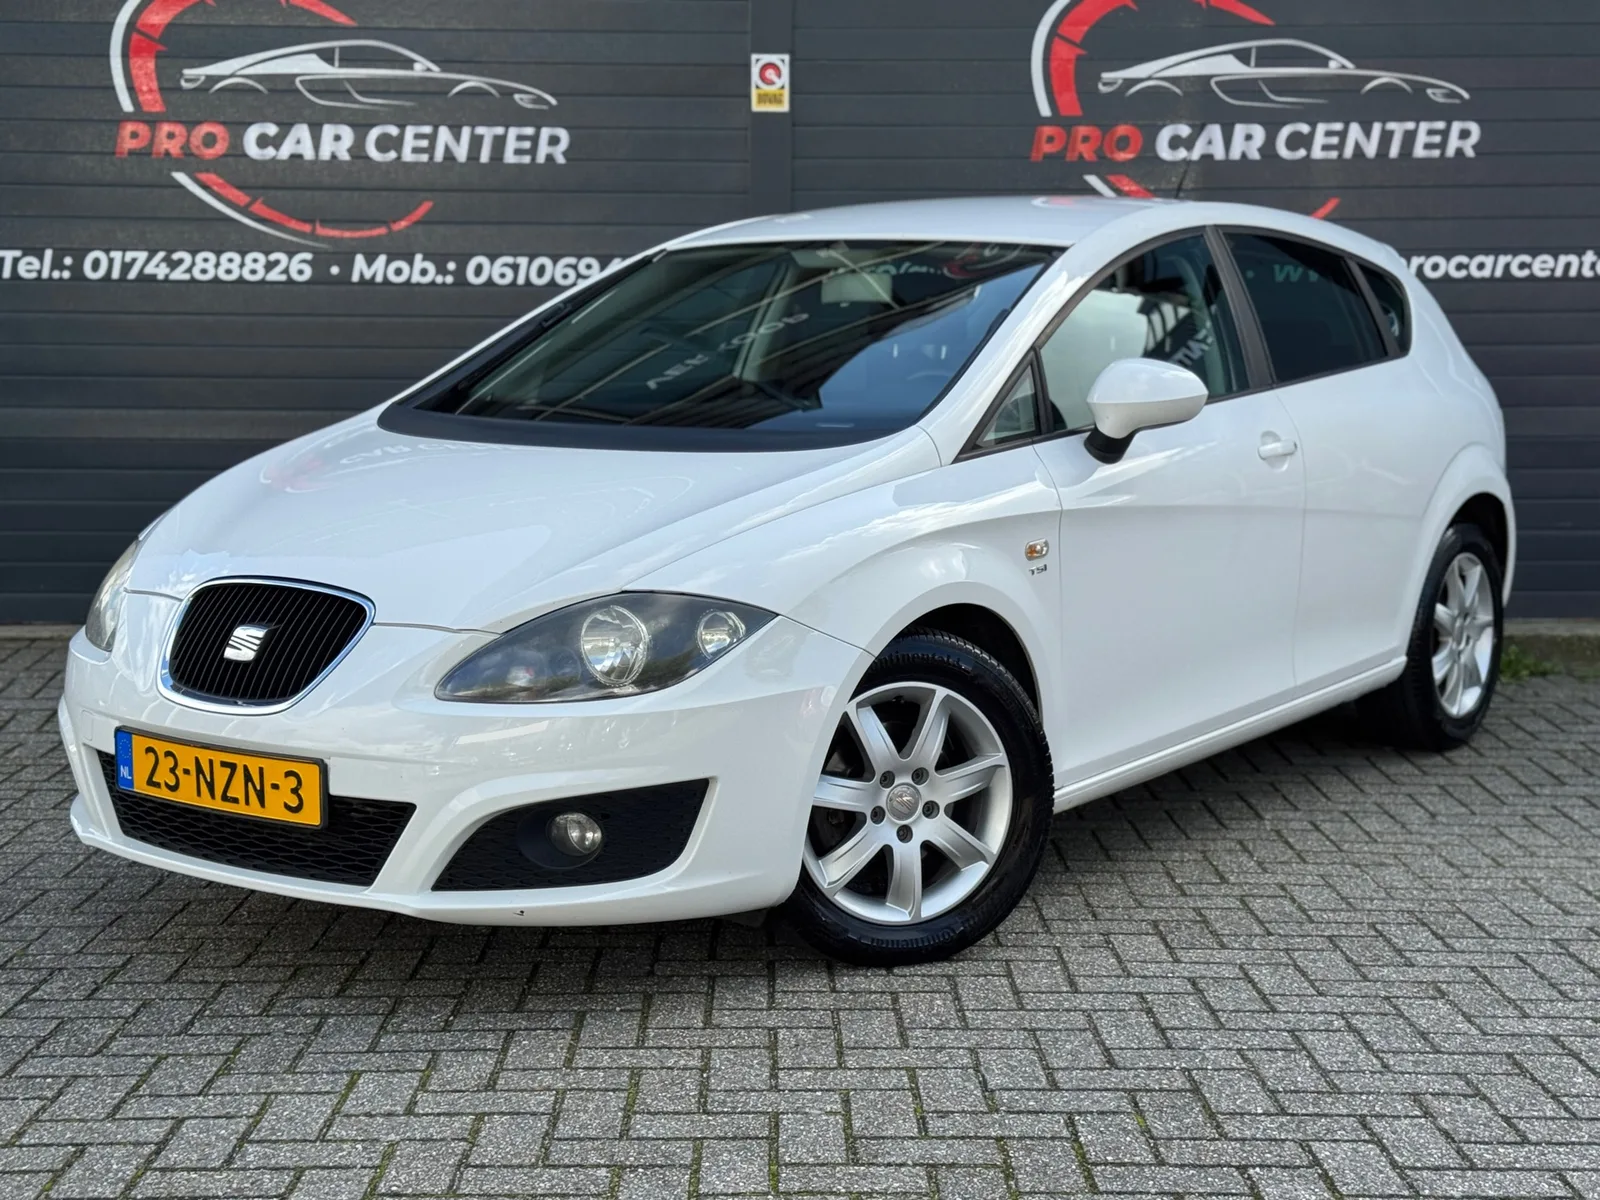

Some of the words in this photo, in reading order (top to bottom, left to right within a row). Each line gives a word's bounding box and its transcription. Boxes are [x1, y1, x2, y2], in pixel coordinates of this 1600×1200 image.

[115, 121, 229, 158] PRO
[242, 122, 353, 161] CAR
[364, 125, 571, 164] CENTER
[1030, 123, 1143, 162] PRO
[1155, 123, 1266, 162] CAR
[1275, 120, 1481, 159] CENTER
[0, 248, 73, 280] Tel.:
[83, 250, 312, 283] 0174288826
[351, 253, 456, 285] Mob.:
[1400, 250, 1600, 280] rocarcent
[120, 765, 132, 780] NL
[144, 746, 304, 814] 23-NZN-3
